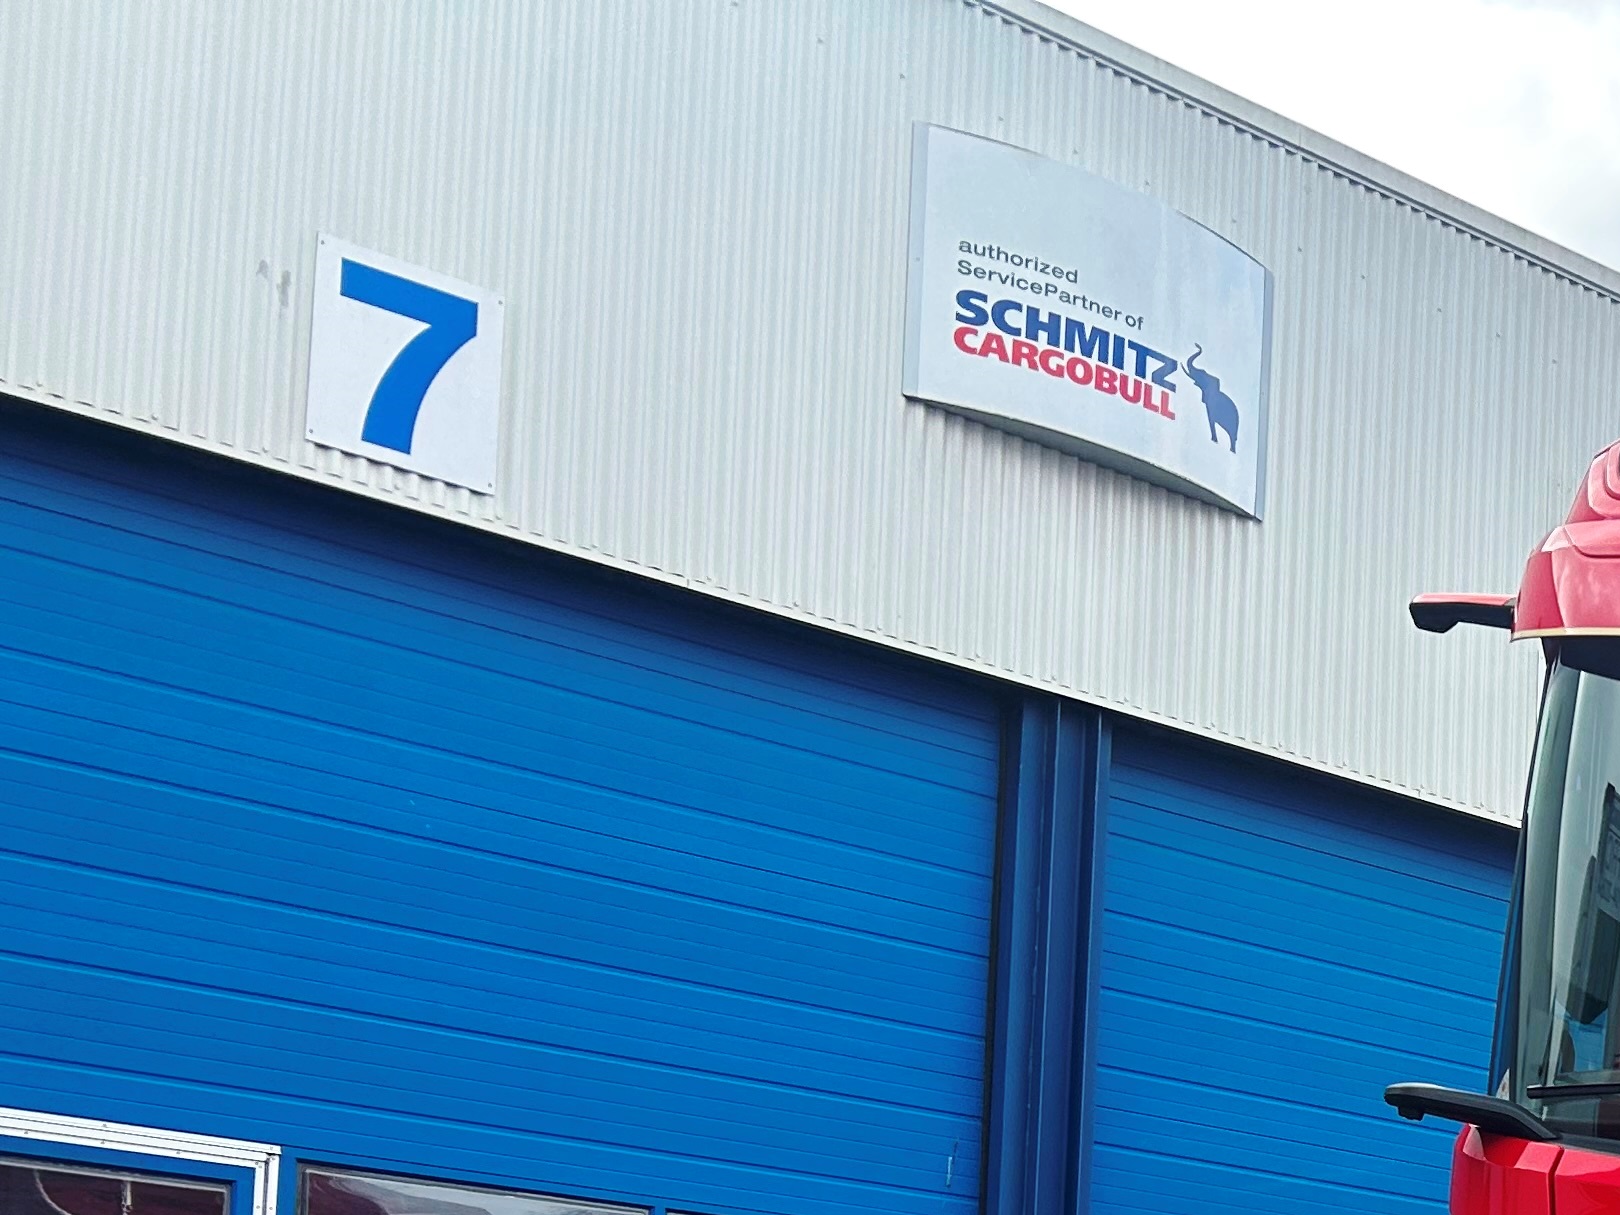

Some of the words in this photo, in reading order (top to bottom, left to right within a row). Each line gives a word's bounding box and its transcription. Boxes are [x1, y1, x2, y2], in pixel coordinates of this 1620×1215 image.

[958, 240, 1078, 284] authorized
[340, 257, 479, 455] 7
[955, 289, 1178, 393] SCHMITZ
[1125, 314, 1144, 330] of
[953, 326, 1176, 420] CARGOBULL
